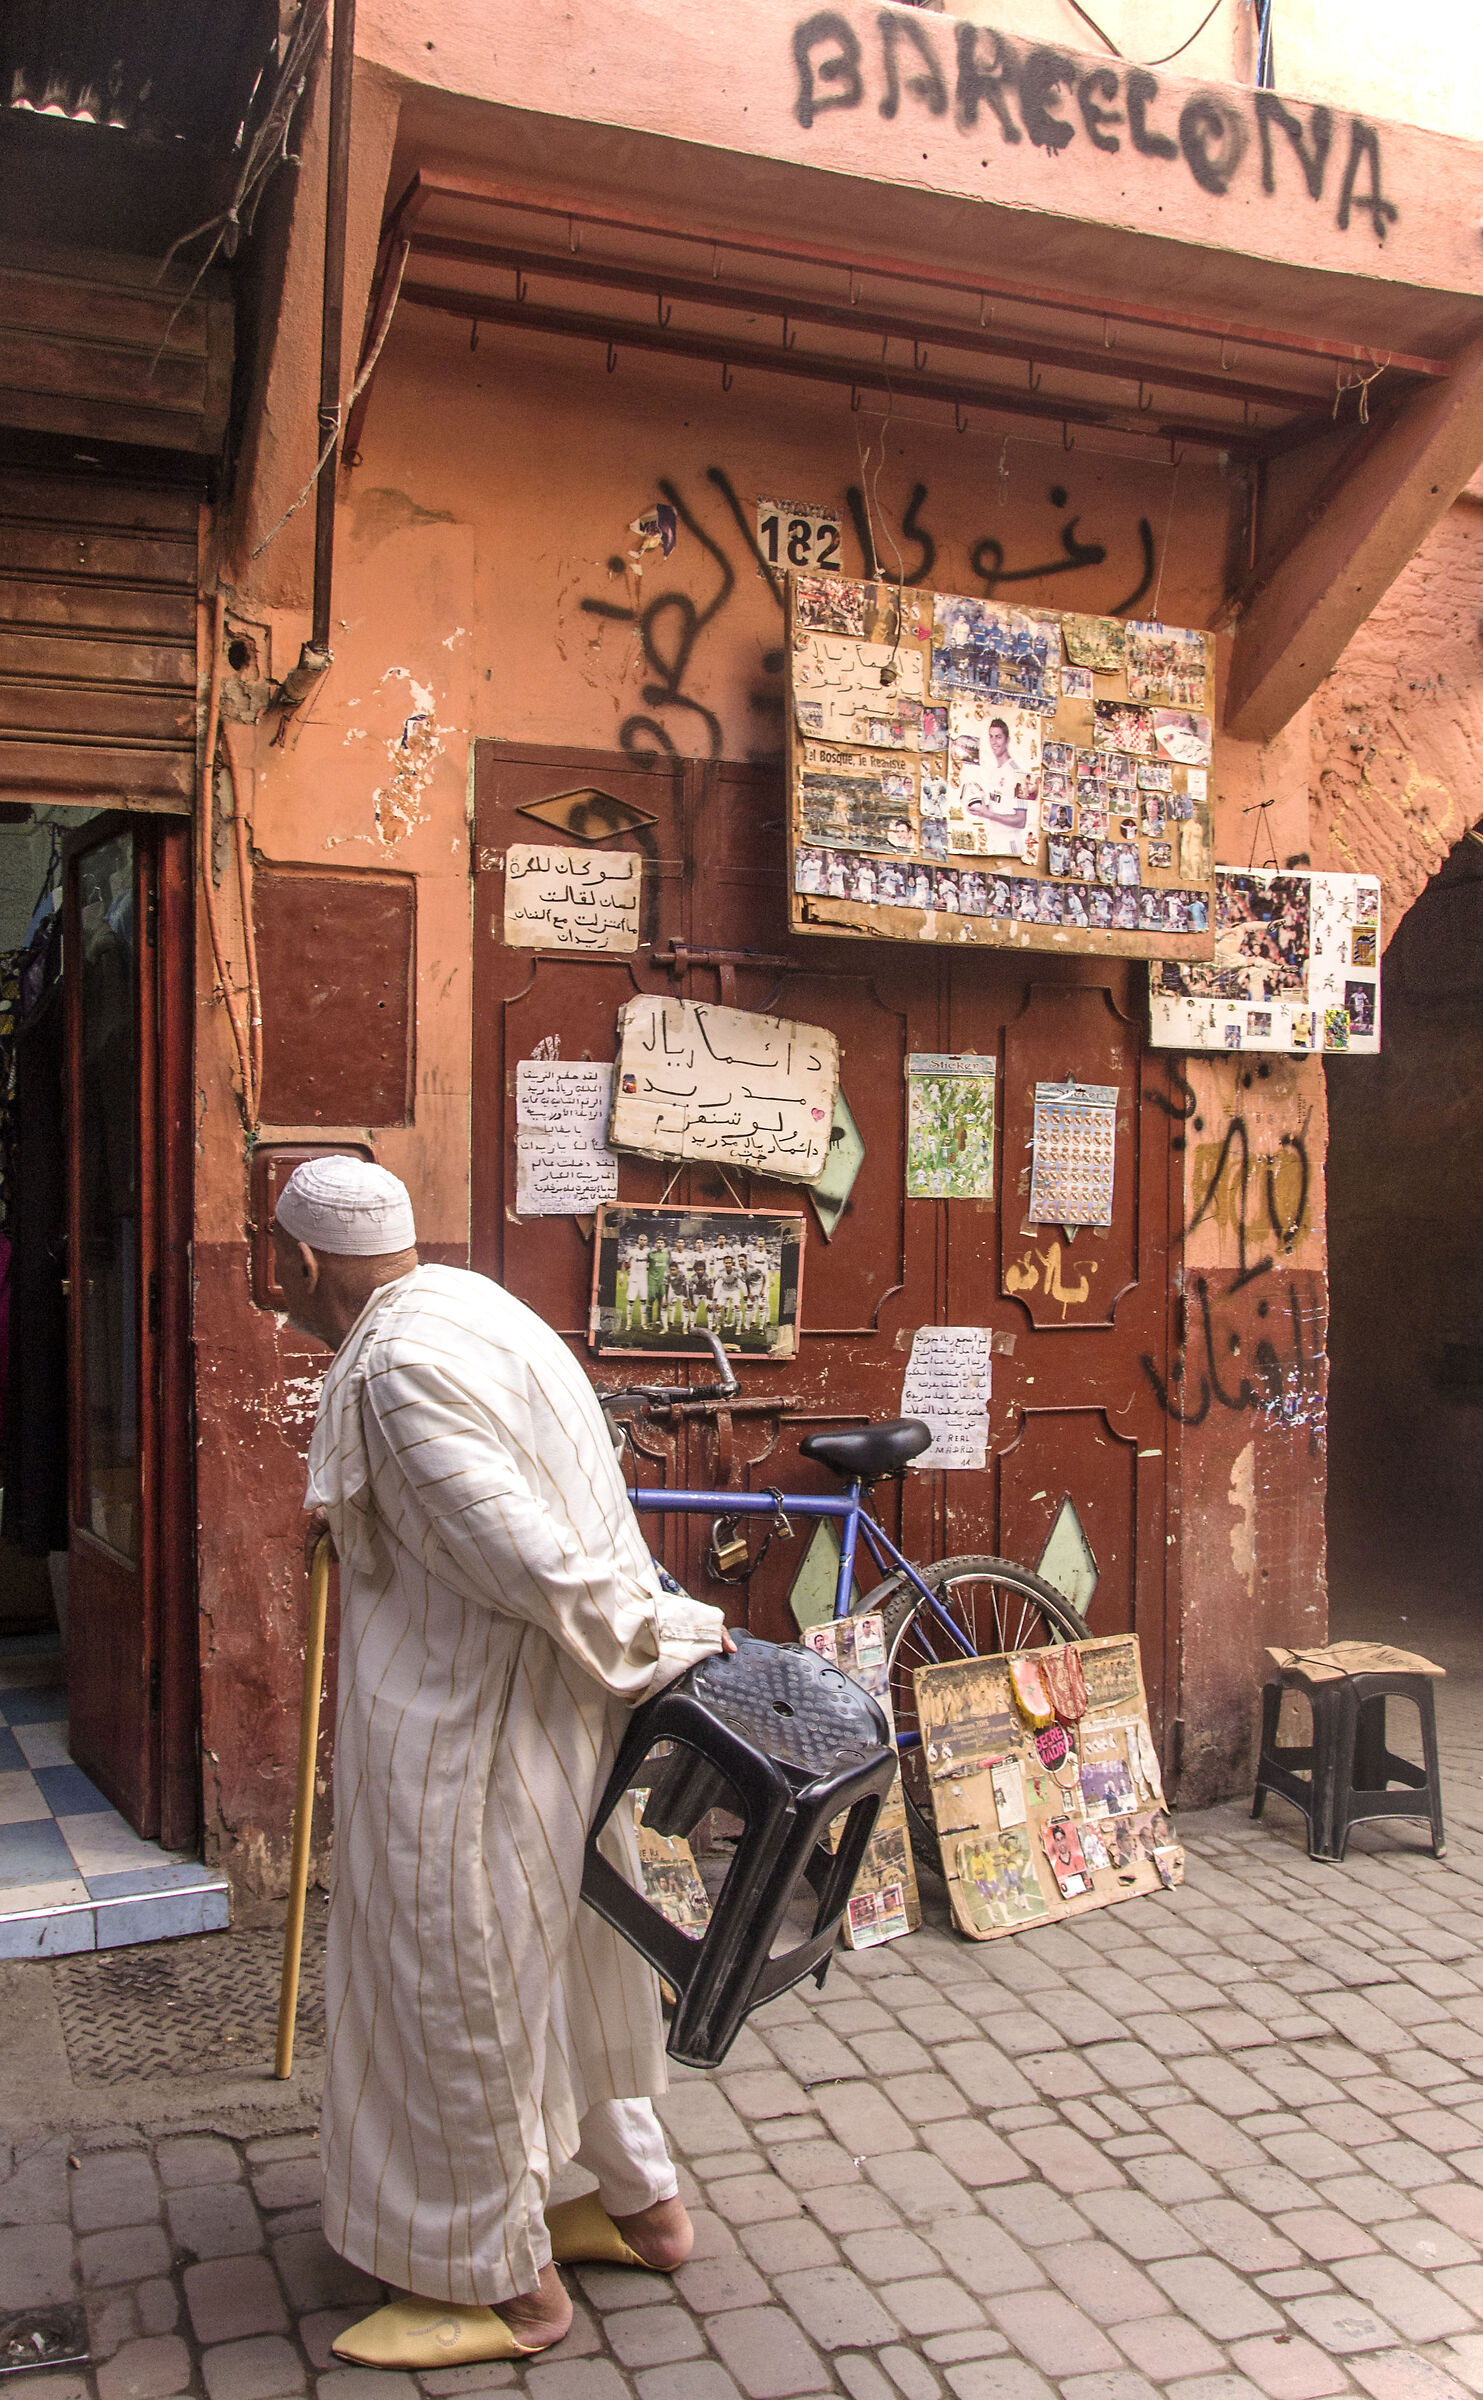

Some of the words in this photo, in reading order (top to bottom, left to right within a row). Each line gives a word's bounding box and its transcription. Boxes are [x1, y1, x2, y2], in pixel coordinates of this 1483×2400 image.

[761, 515, 842, 572] 182
[510, 856, 551, 879] للكرة
[554, 857, 592, 876] كان
[582, 860, 634, 886] لو
[539, 885, 596, 906] لقالت
[600, 894, 637, 910] لسان
[553, 914, 568, 930] مع
[557, 928, 610, 948] زيدان
[928, 1059, 982, 1070] Sticker
[643, 1076, 807, 1109] مدريد
[1056, 1087, 1104, 1100] Scker
[947, 1434, 970, 1443] REAL
